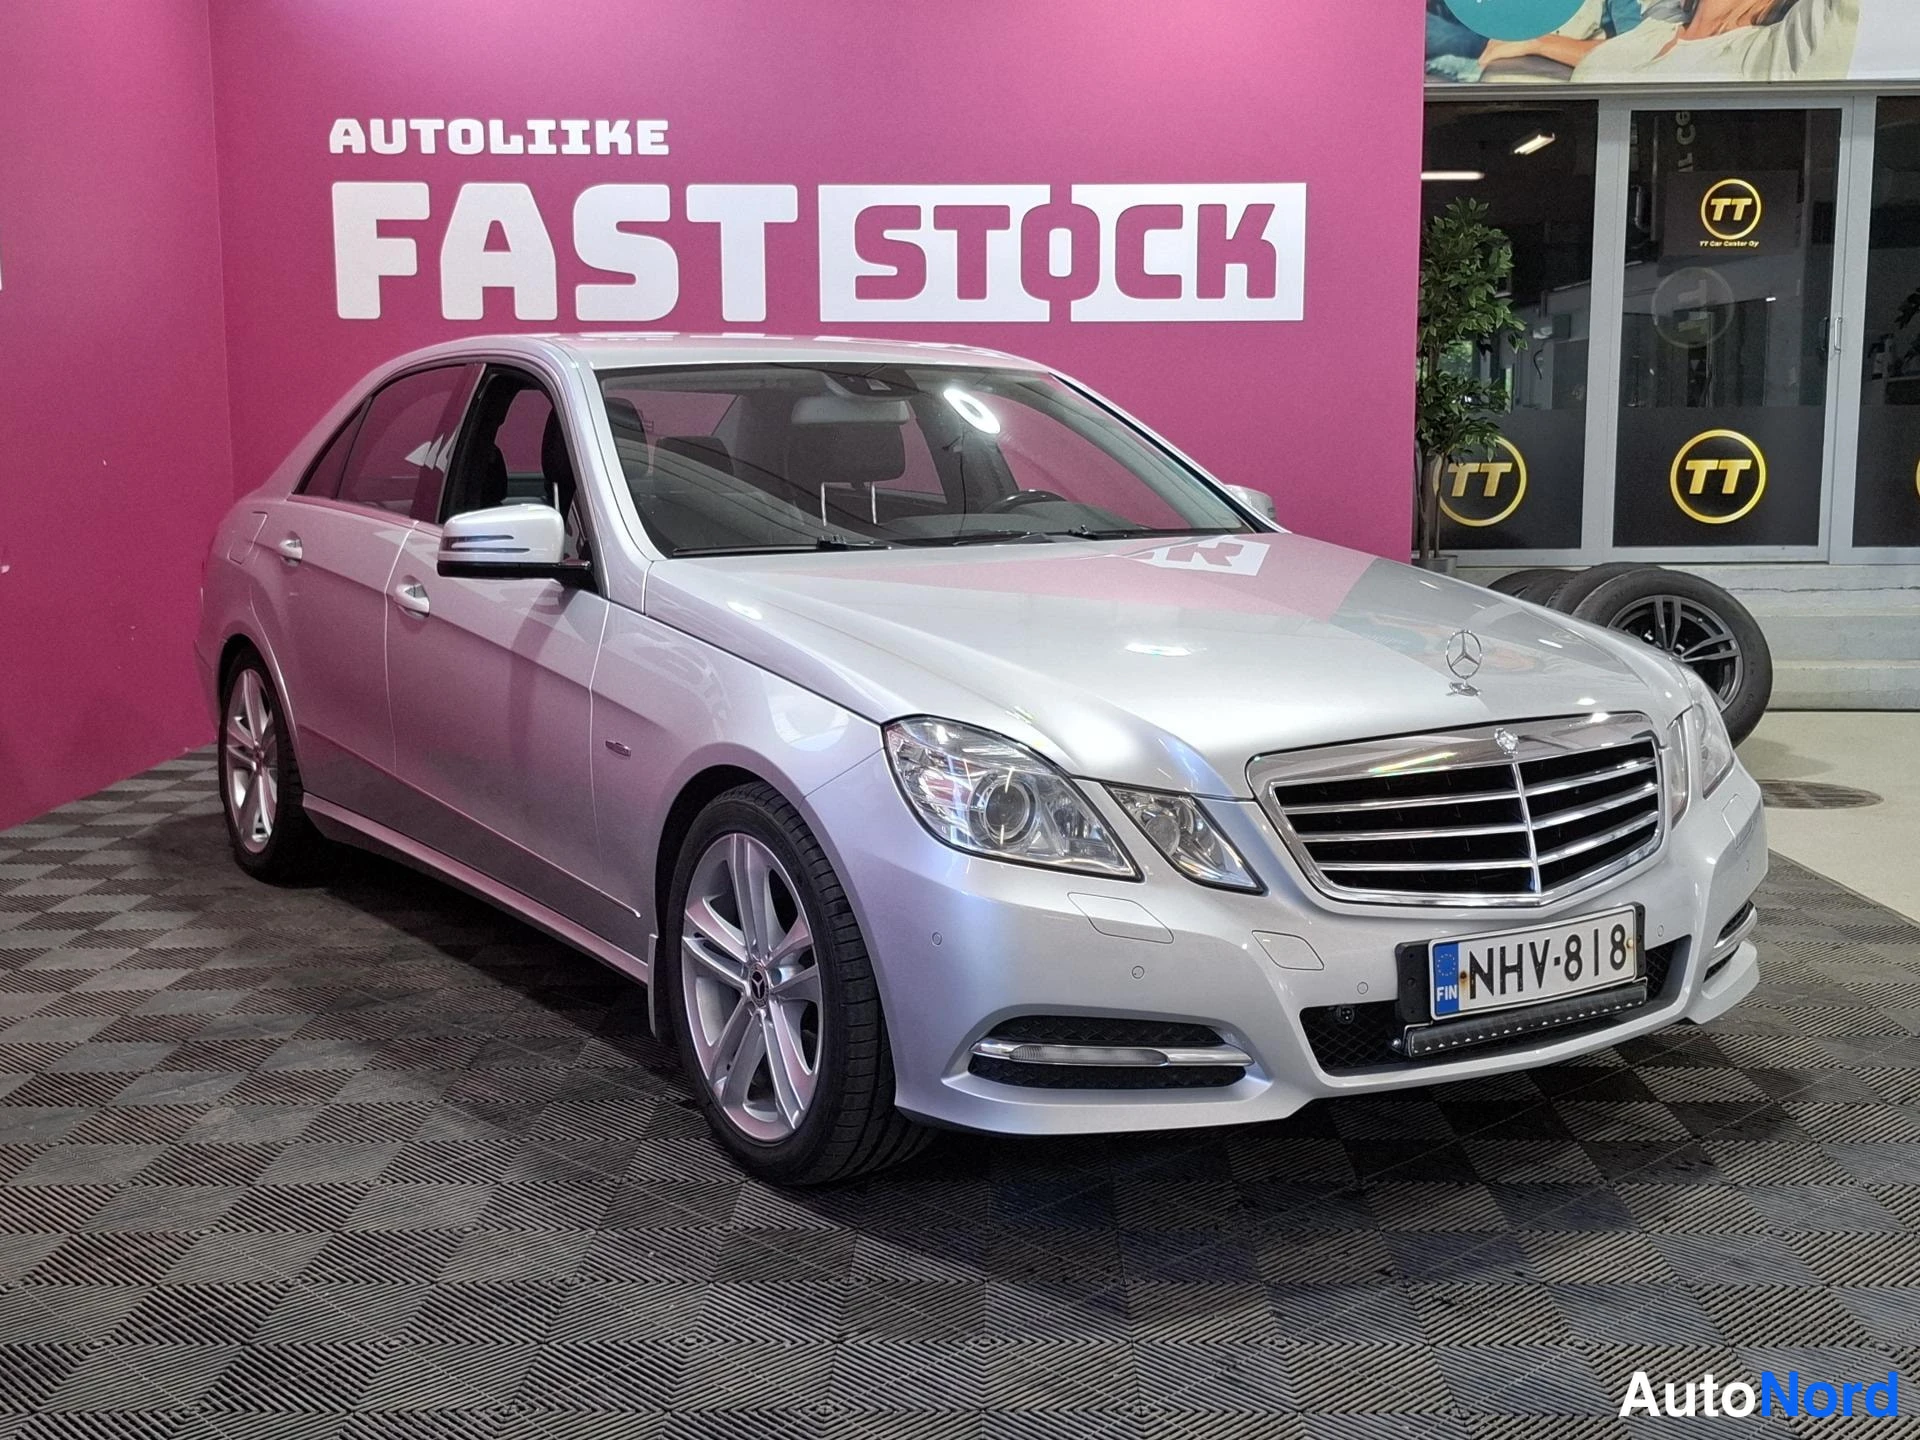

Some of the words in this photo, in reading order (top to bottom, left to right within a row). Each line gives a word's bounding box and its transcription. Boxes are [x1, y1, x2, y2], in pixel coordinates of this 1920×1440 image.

[329, 118, 670, 156] AUTOLIIKE
[1710, 198, 1753, 222] TT
[331, 182, 799, 322] FAST
[854, 203, 1277, 301] STOCK
[1709, 240, 1723, 248] Car
[1748, 240, 1760, 249] Oy
[1447, 461, 1512, 498] TT
[1684, 458, 1753, 495] TT
[1468, 923, 1627, 1000] NHV-818
[1436, 983, 1459, 1003] FIN
